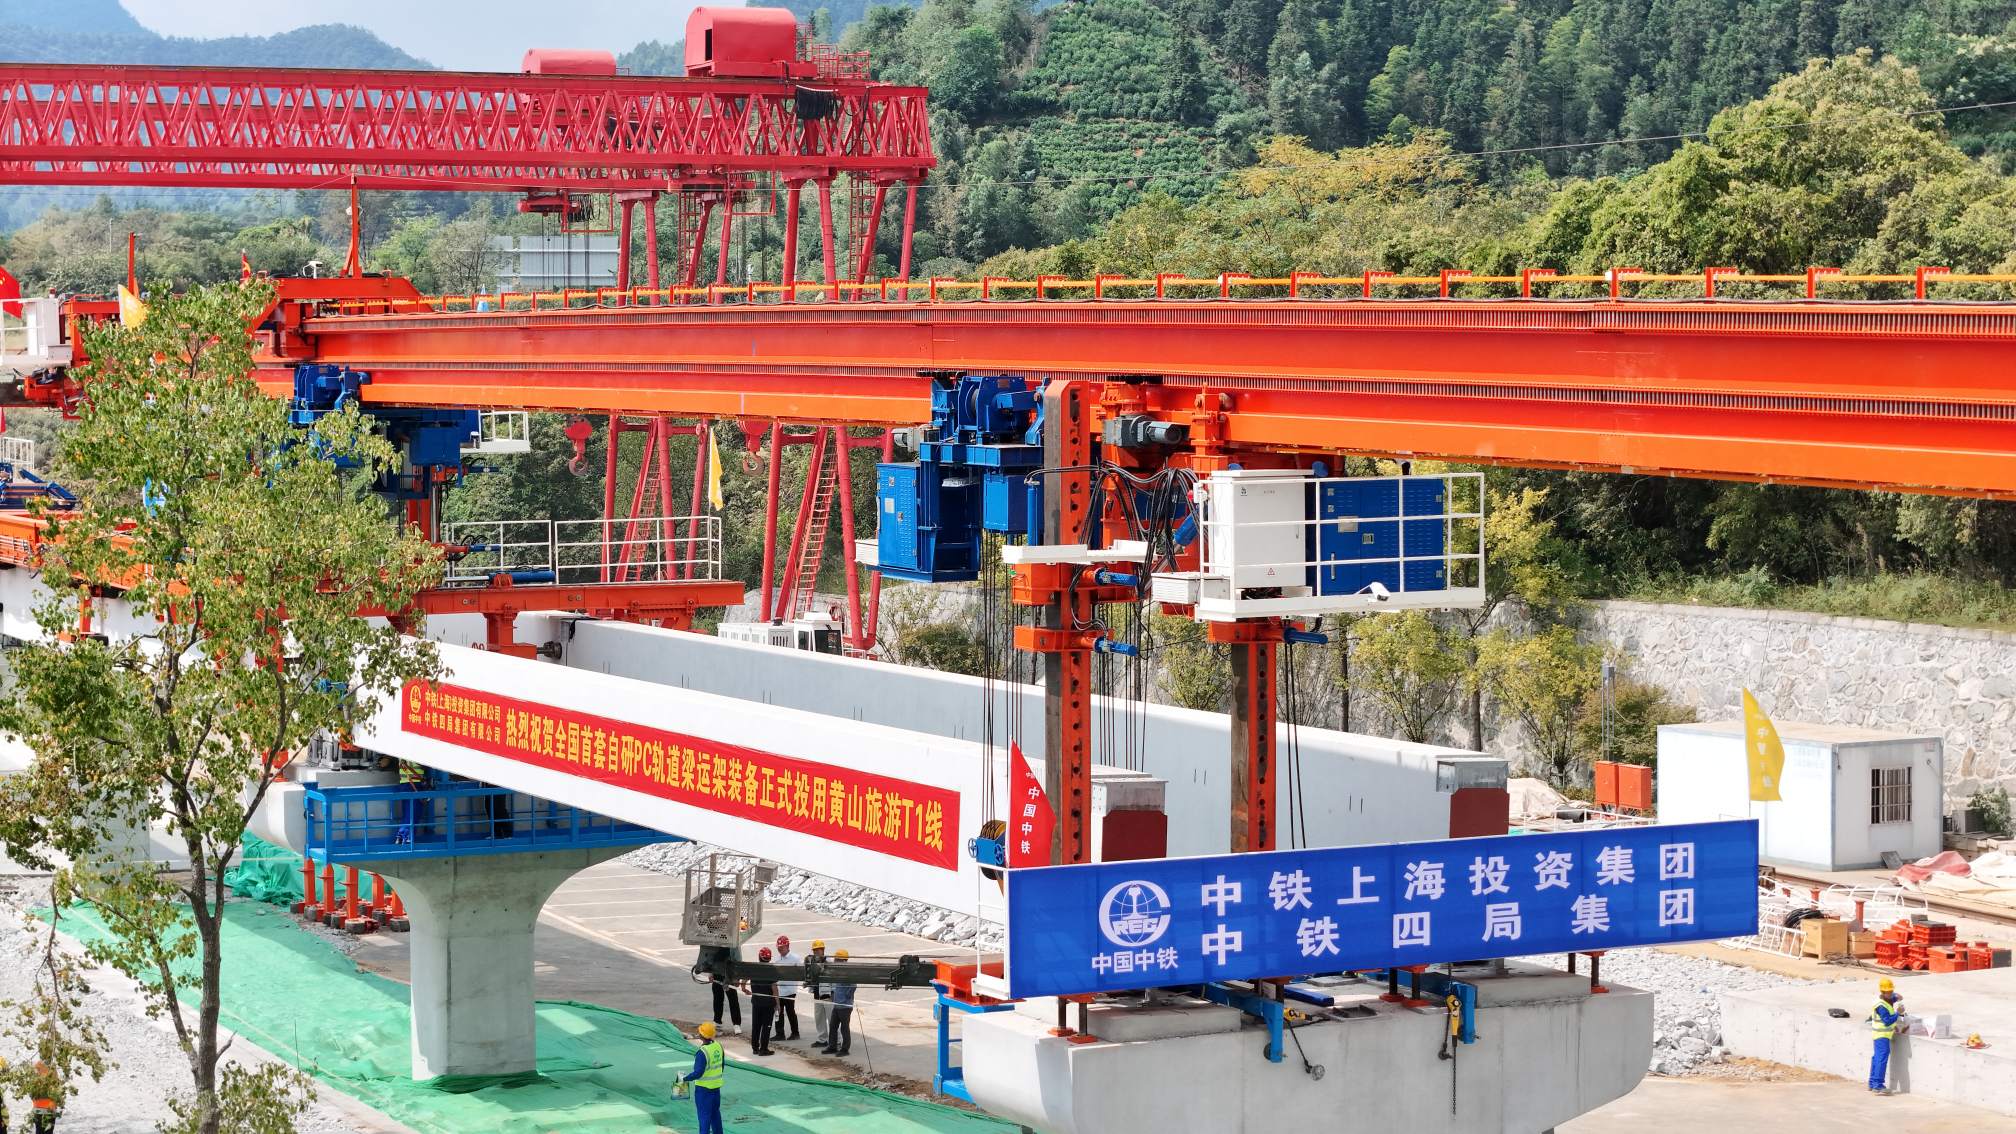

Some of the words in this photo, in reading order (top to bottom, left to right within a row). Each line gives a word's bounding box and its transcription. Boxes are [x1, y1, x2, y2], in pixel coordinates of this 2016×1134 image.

[506, 708, 943, 852] 热烈祝贺全国首套自研PC轨道梁运架装备正式投用黄山旅游T1线
[1021, 786, 1040, 855] 中国中铁
[1201, 842, 1696, 917] 中铁上海投资集团
[1091, 946, 1179, 975] 中国中铁
[1202, 888, 1696, 966] 中铁四局集团
